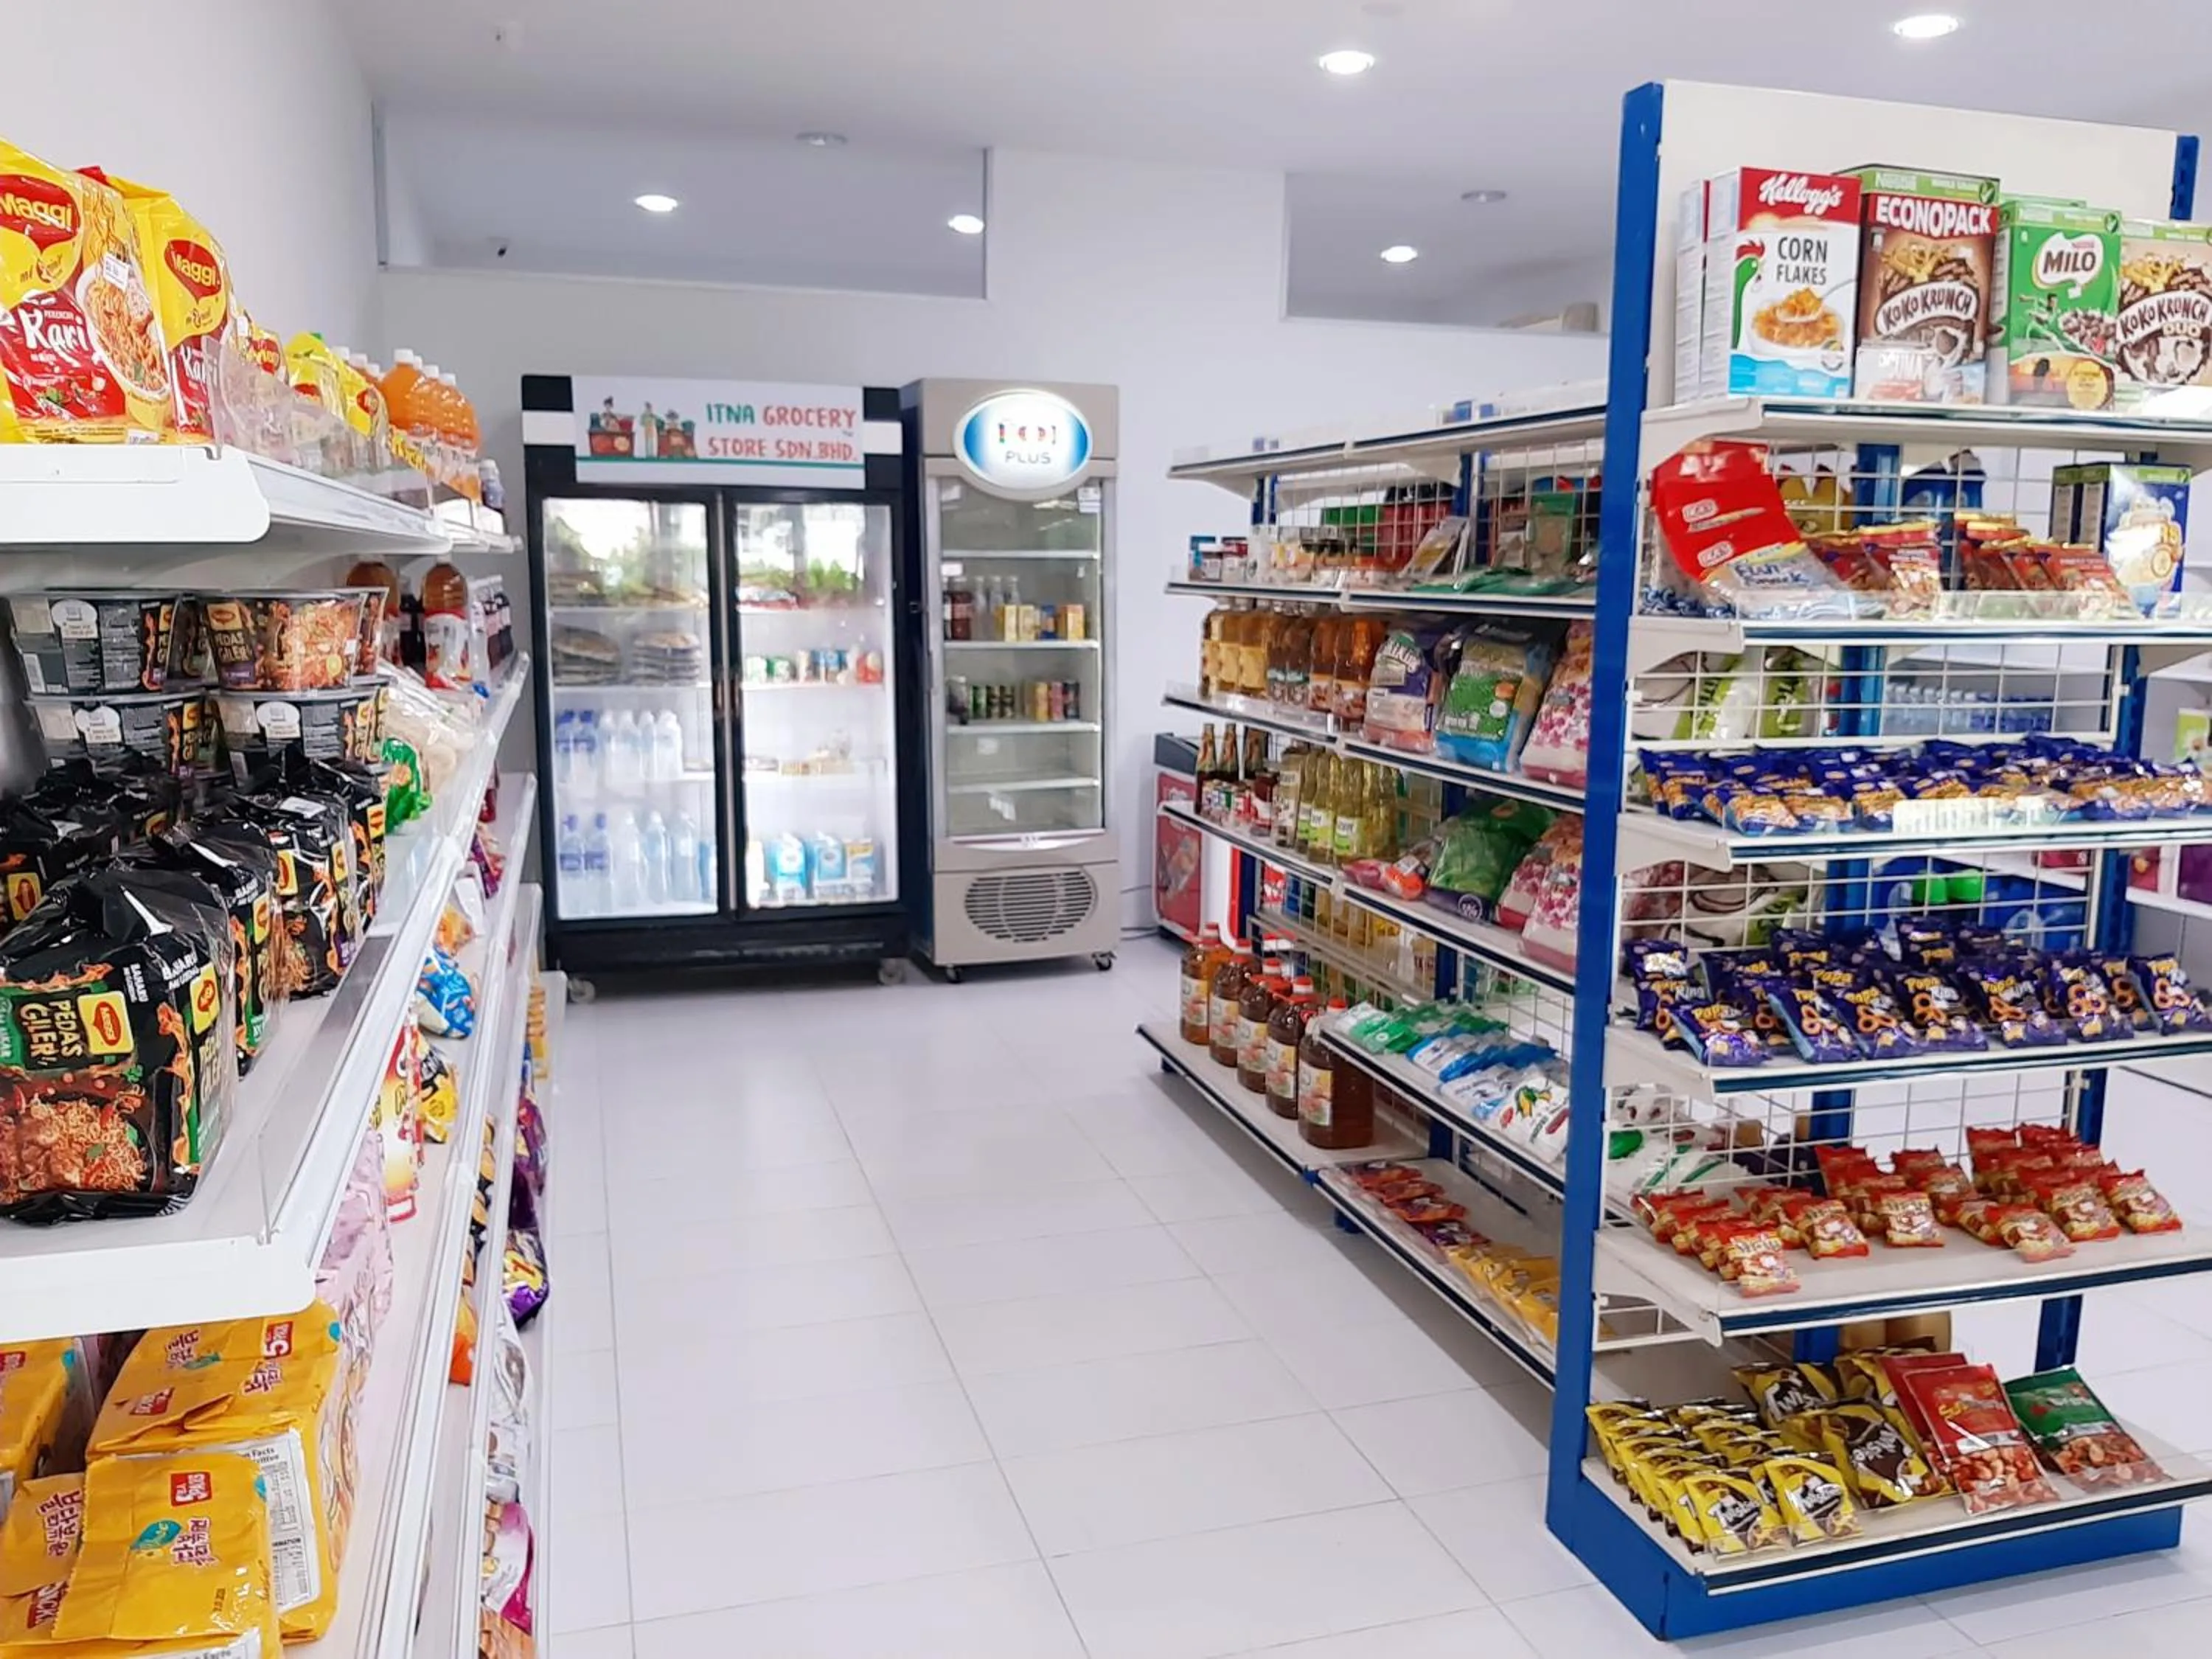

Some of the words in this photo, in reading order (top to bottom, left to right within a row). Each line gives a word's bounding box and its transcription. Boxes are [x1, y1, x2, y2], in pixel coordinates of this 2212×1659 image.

[1759, 173, 1843, 215] Kellogg's
[0, 192, 72, 233] Maggi
[1876, 196, 1992, 237] ECONOPACK
[1778, 236, 1828, 263] CORN
[2043, 250, 2096, 274] MILO
[1777, 264, 1827, 285] FLAKES
[1882, 298, 1919, 330] KOKO
[1920, 284, 1973, 316] KRUNCH
[2120, 305, 2157, 339] KOKO
[2157, 297, 2210, 325] KRUNCH
[2162, 322, 2201, 338] DUO
[706, 403, 755, 425] ITNA
[762, 405, 857, 429] GROCERY
[708, 437, 767, 457] STORE
[1005, 451, 1051, 464] PLUS
[49, 999, 83, 1057] PEDAS
